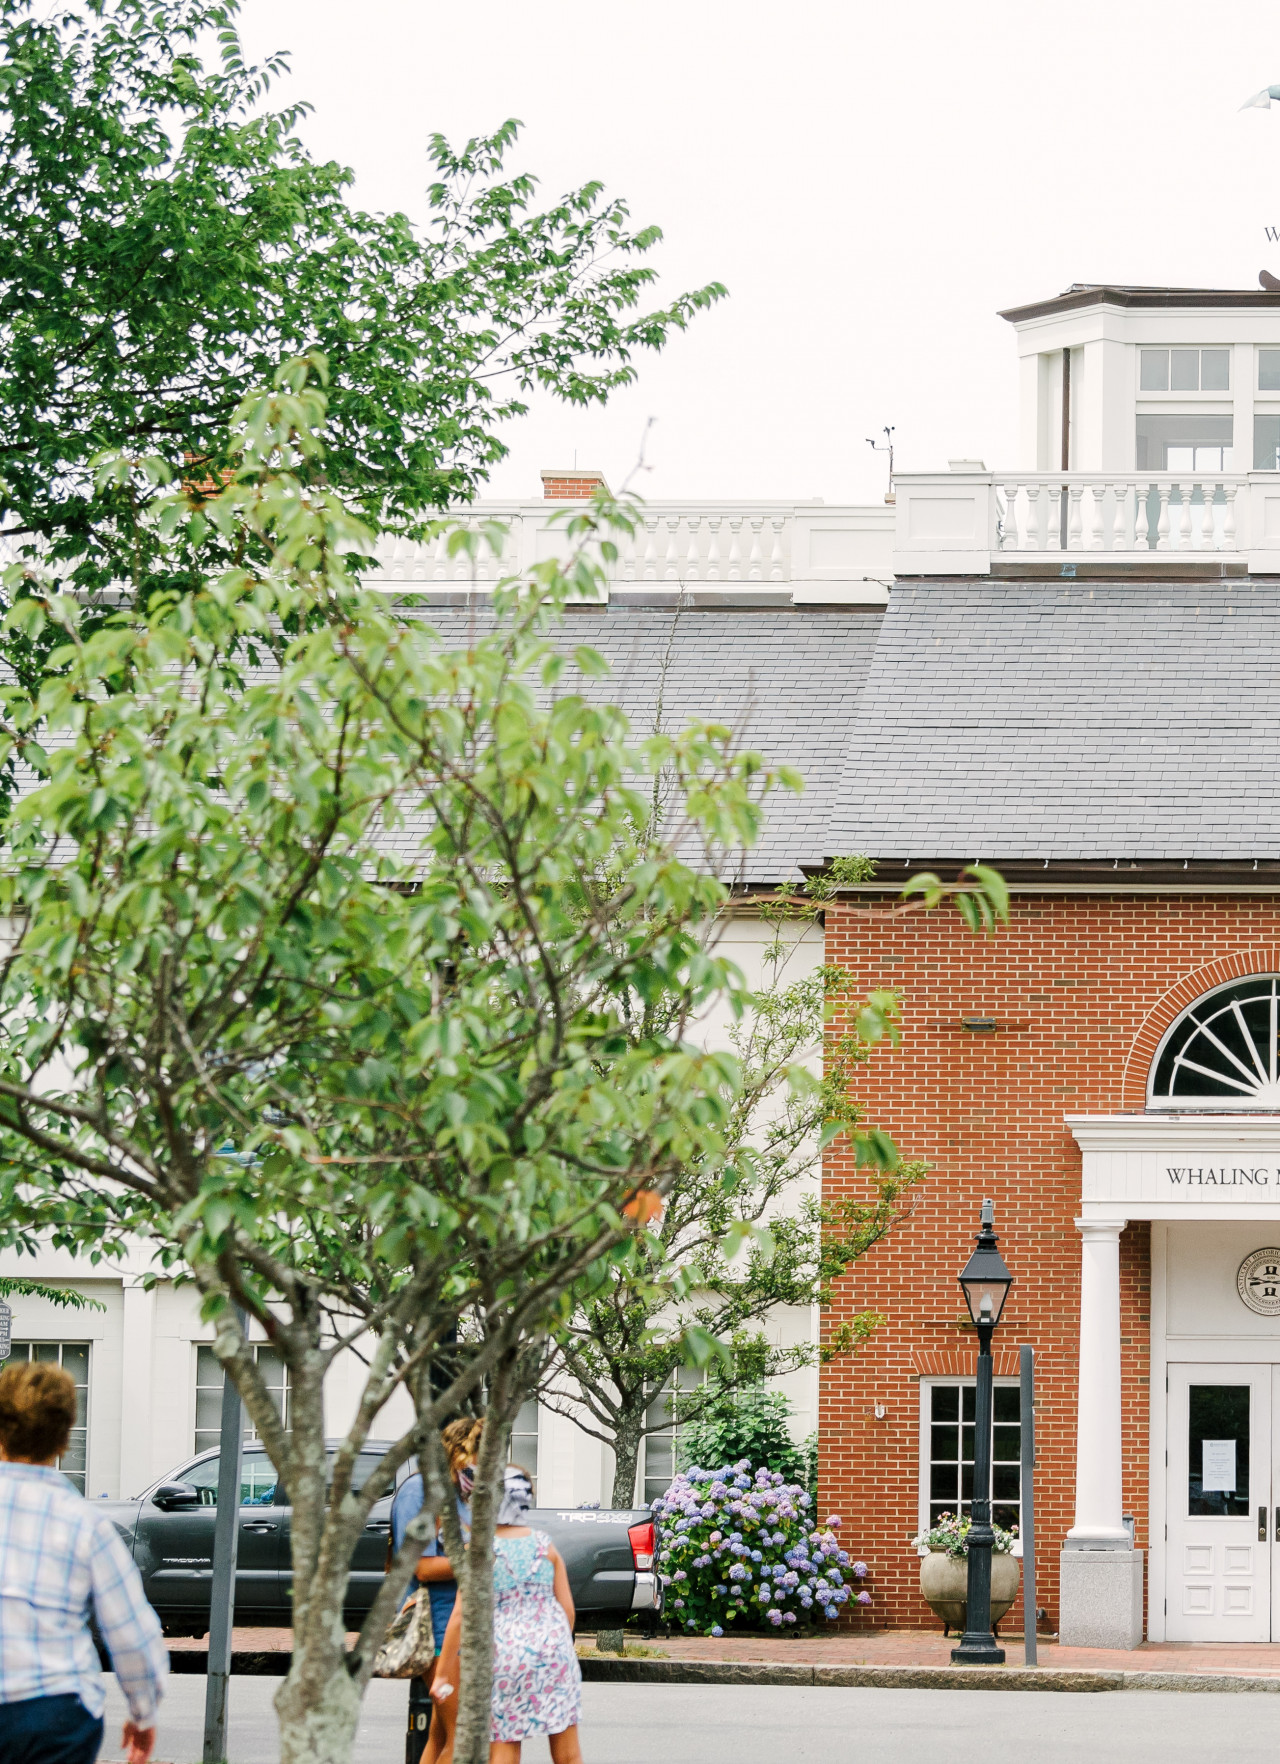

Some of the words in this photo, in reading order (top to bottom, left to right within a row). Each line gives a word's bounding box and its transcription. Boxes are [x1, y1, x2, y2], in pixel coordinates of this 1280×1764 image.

[1166, 1168, 1269, 1186] WHALING
[1239, 1258, 1252, 1296] NANTUCKET
[557, 1512, 597, 1523] TRD
